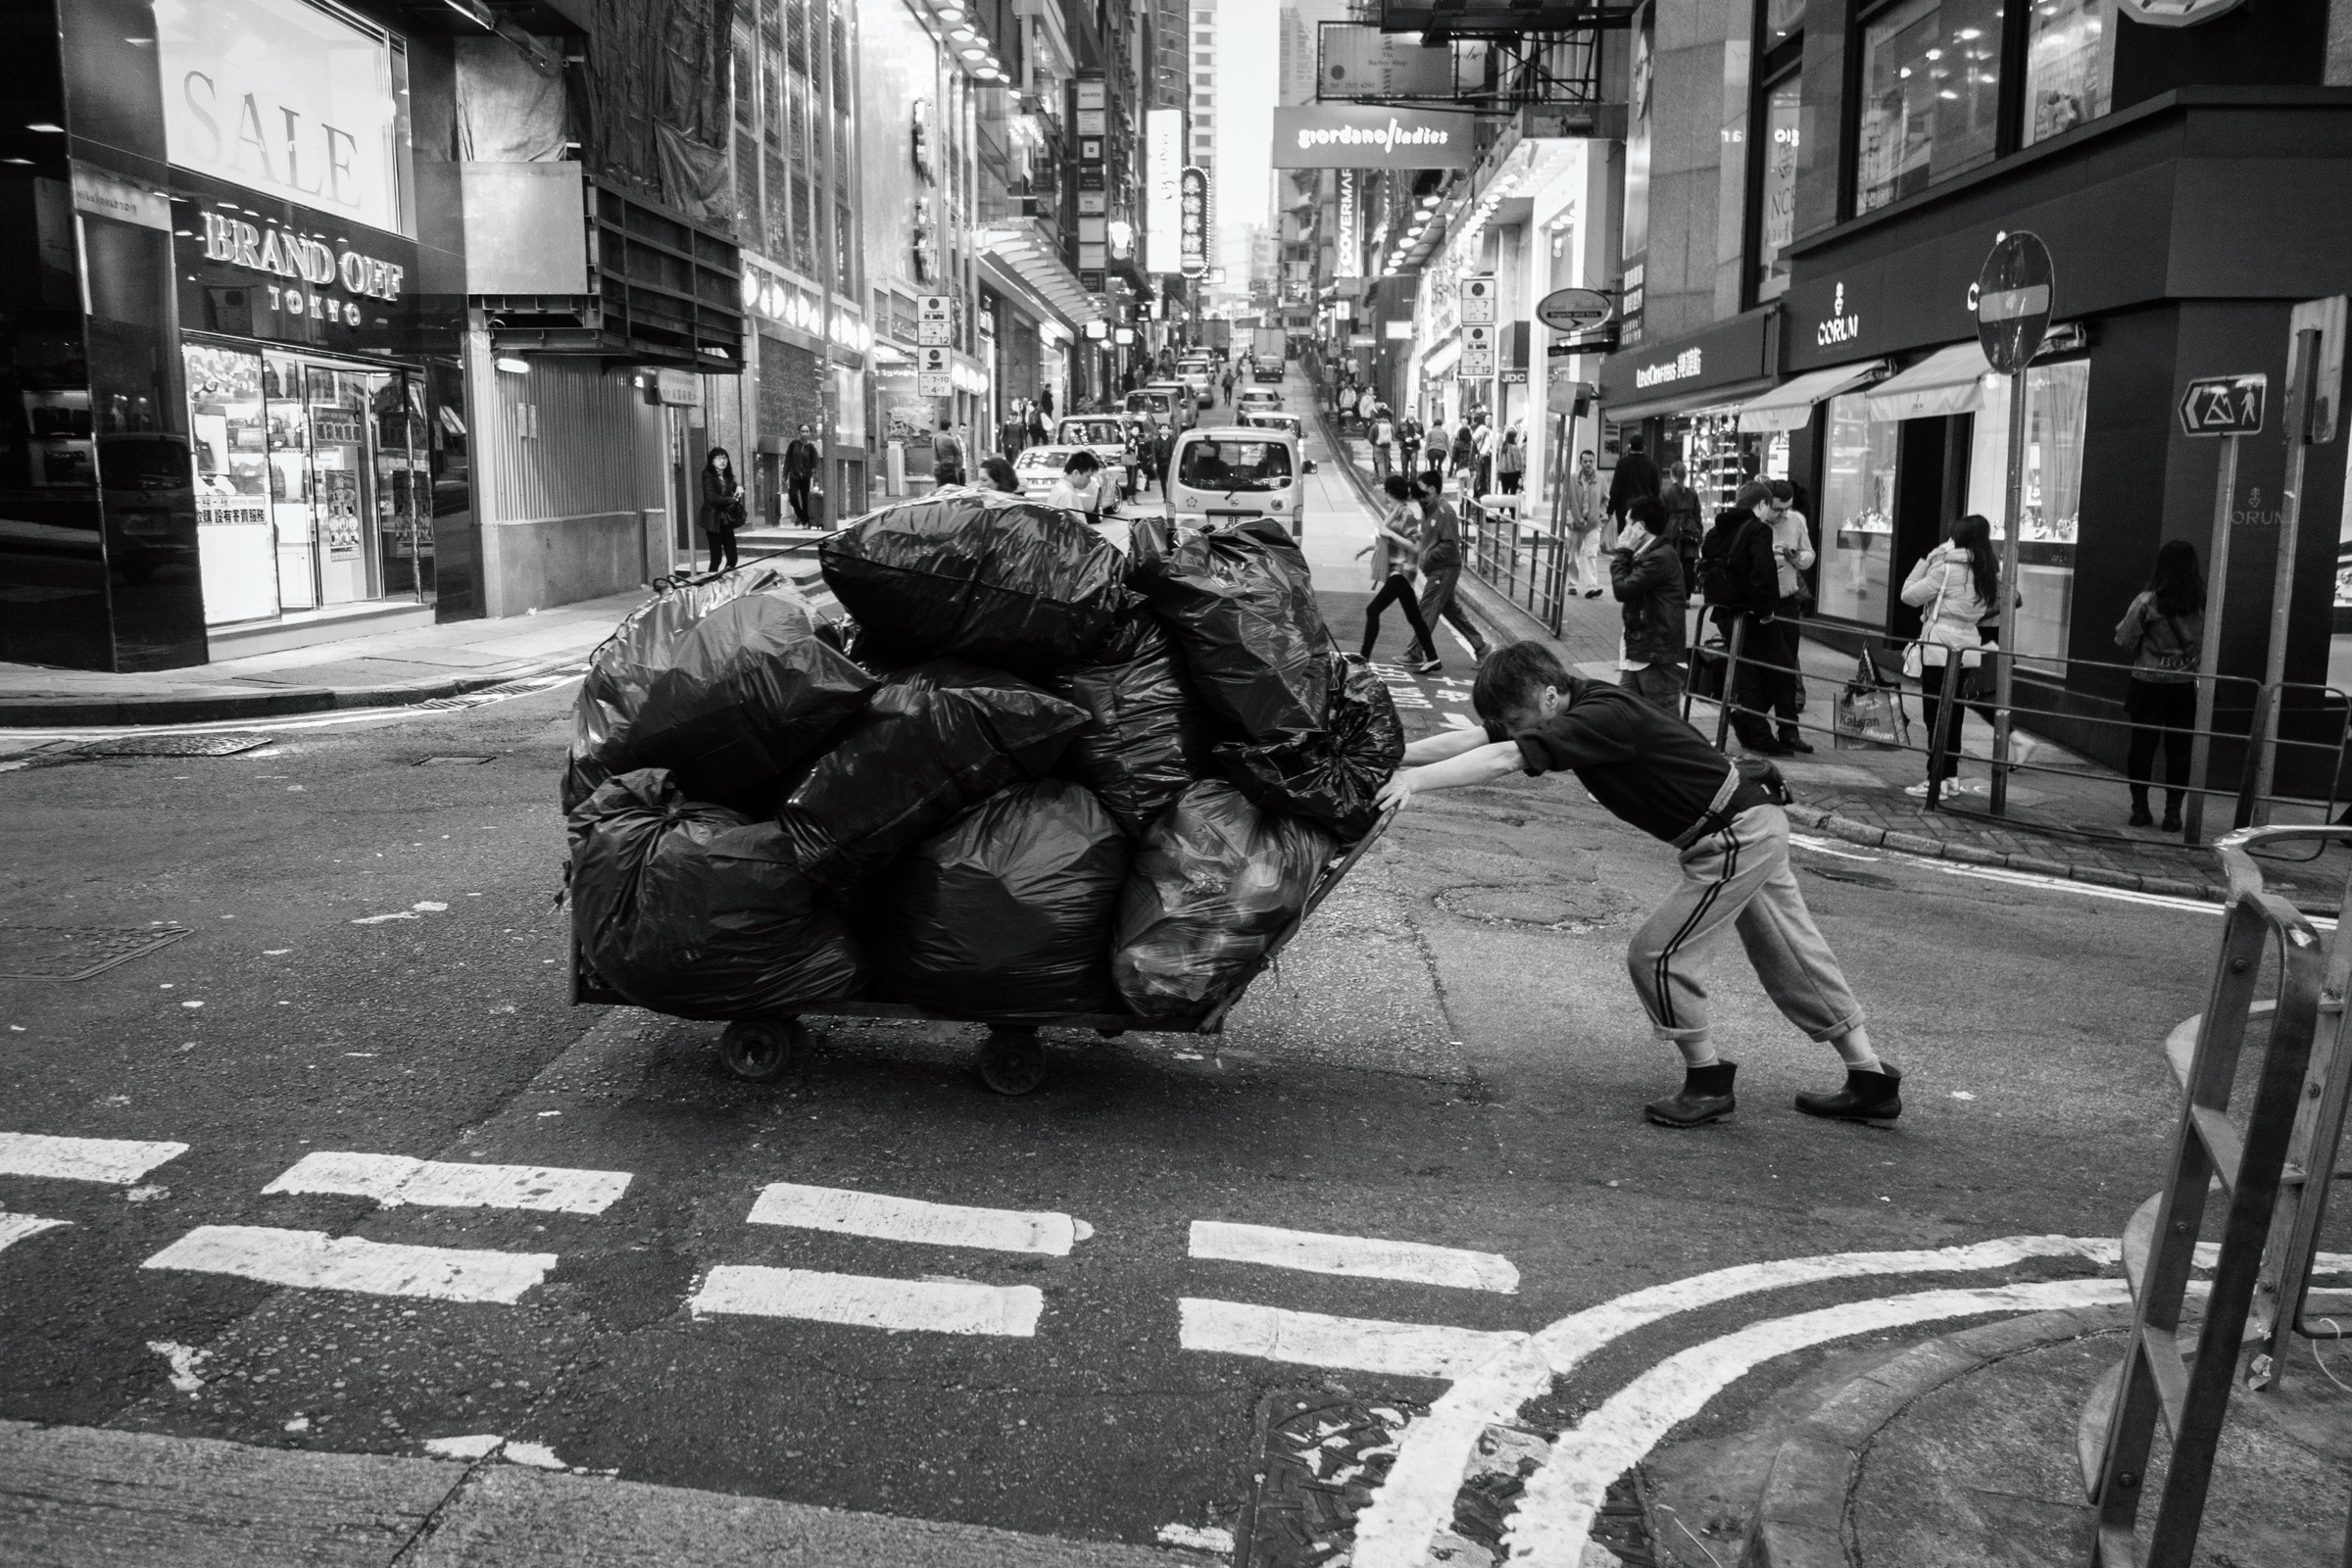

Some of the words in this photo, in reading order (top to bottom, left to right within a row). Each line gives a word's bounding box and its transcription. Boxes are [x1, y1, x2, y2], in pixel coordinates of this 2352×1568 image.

[183, 71, 362, 210] SALE
[199, 211, 336, 285] BRAND
[338, 251, 404, 302] OFF
[268, 285, 361, 326] TOKYO
[1483, 300, 1489, 309] 7
[1483, 313, 1489, 321] 7
[1818, 314, 1859, 346] CORUM
[1482, 353, 1488, 362] 7
[932, 375, 950, 384] 7-10
[1501, 373, 1526, 383] JDC
